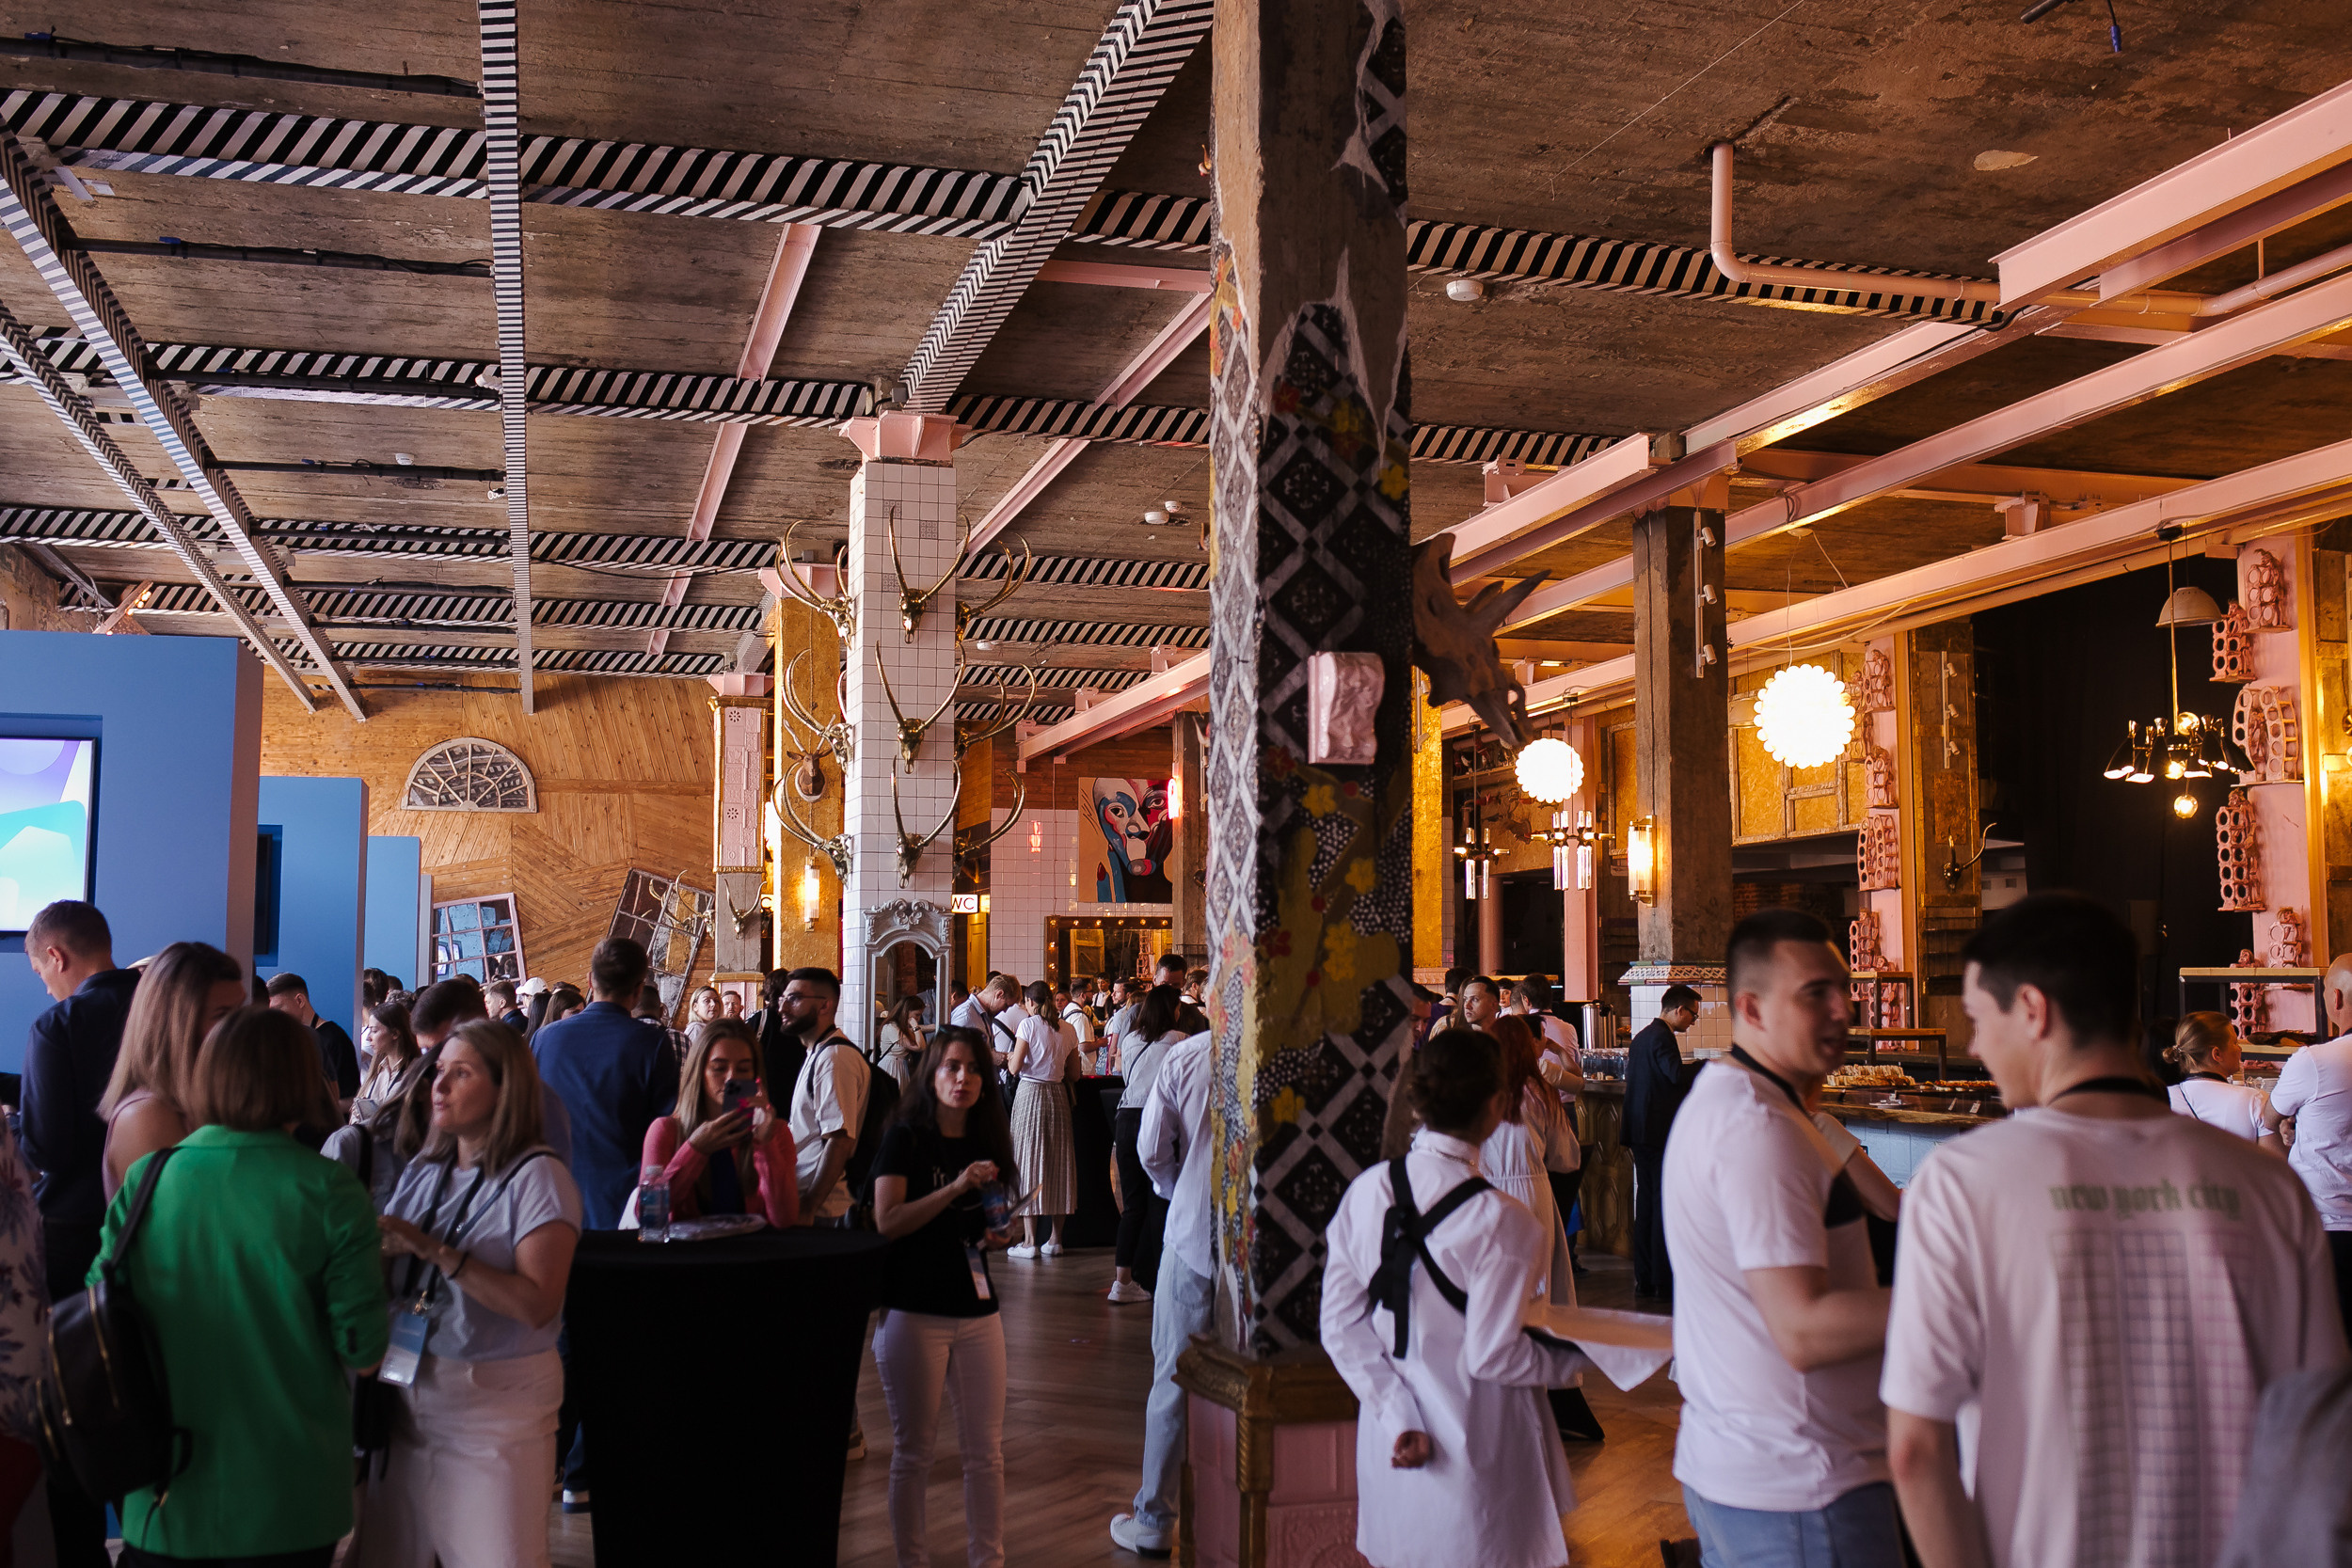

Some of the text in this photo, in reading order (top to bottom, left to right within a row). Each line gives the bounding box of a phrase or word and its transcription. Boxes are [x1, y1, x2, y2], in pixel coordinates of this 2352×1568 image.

[2048, 1177, 2243, 1221] new york city
